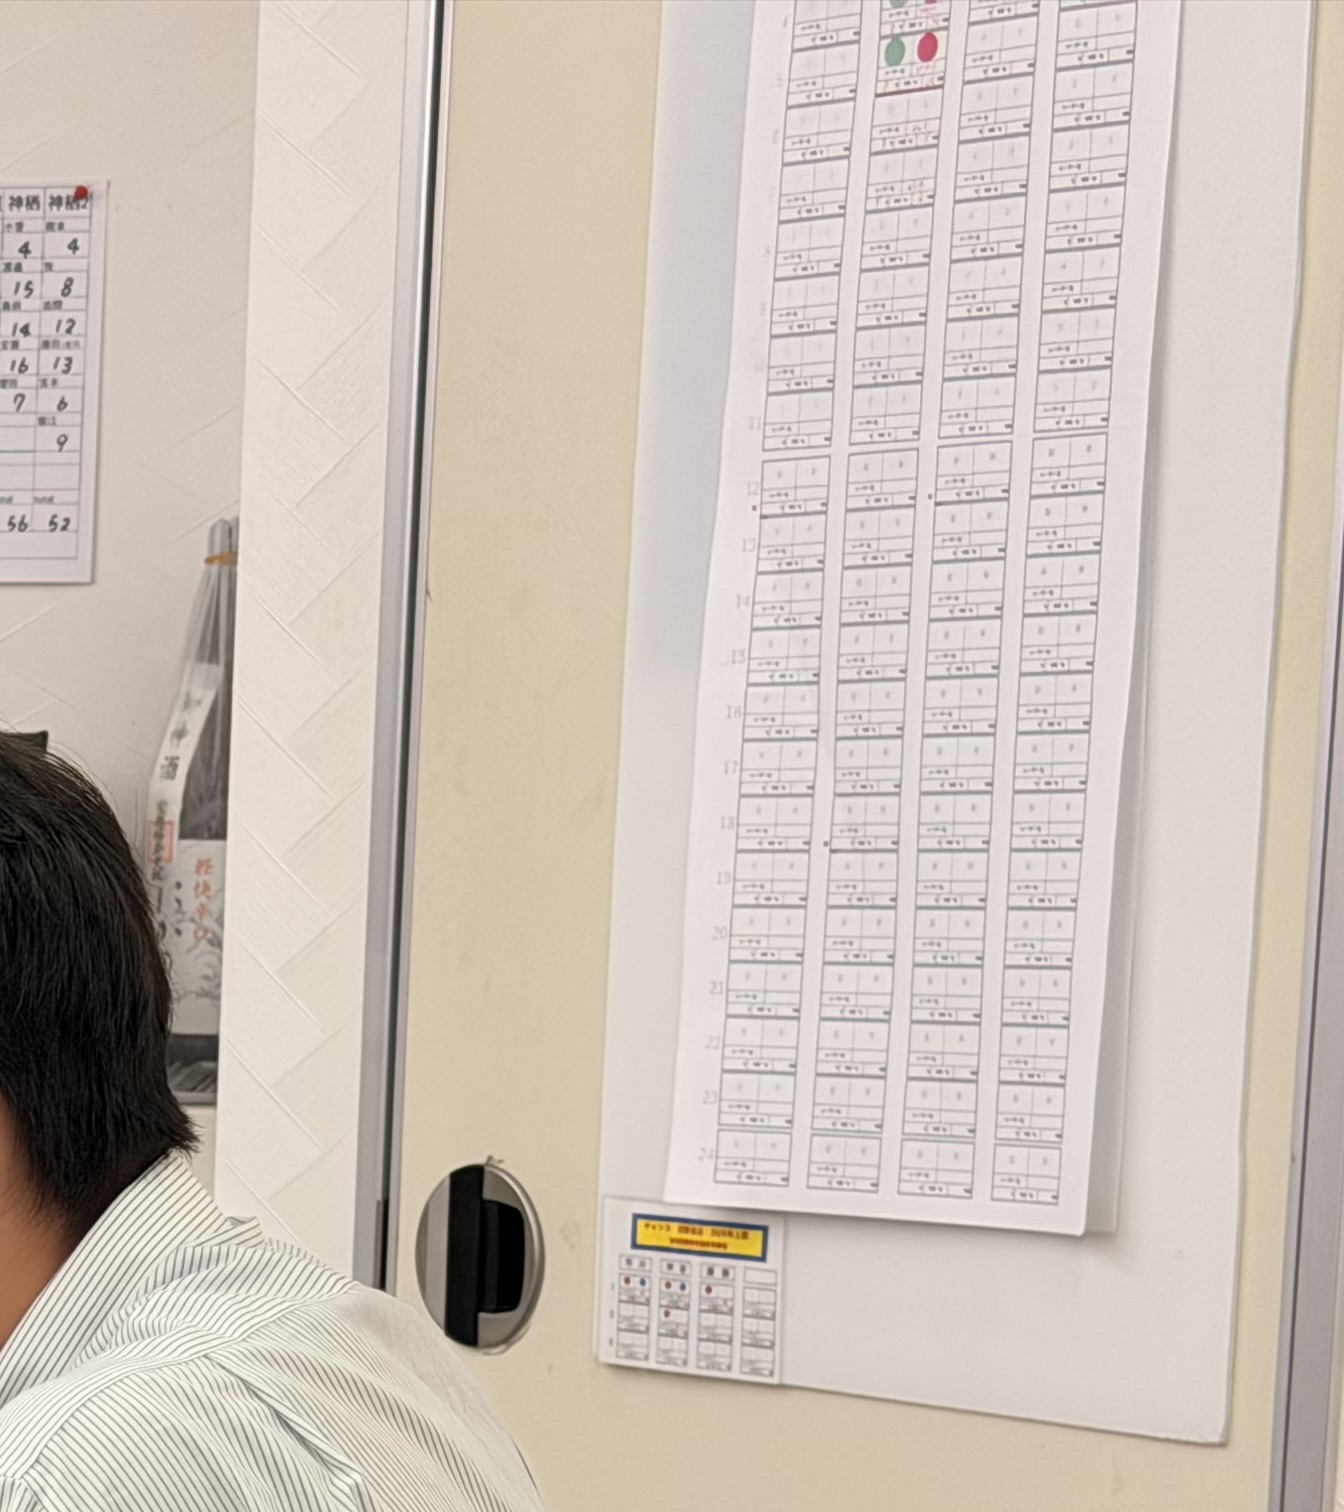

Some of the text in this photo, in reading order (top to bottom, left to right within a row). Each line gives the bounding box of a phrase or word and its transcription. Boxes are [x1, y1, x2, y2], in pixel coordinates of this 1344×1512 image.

[8, 195, 41, 212] 神栖
[18, 241, 32, 258] 4
[67, 237, 80, 255] 4
[13, 279, 33, 298] 15
[60, 276, 73, 297] 8
[7, 514, 28, 532] 56
[48, 513, 71, 532] 52
